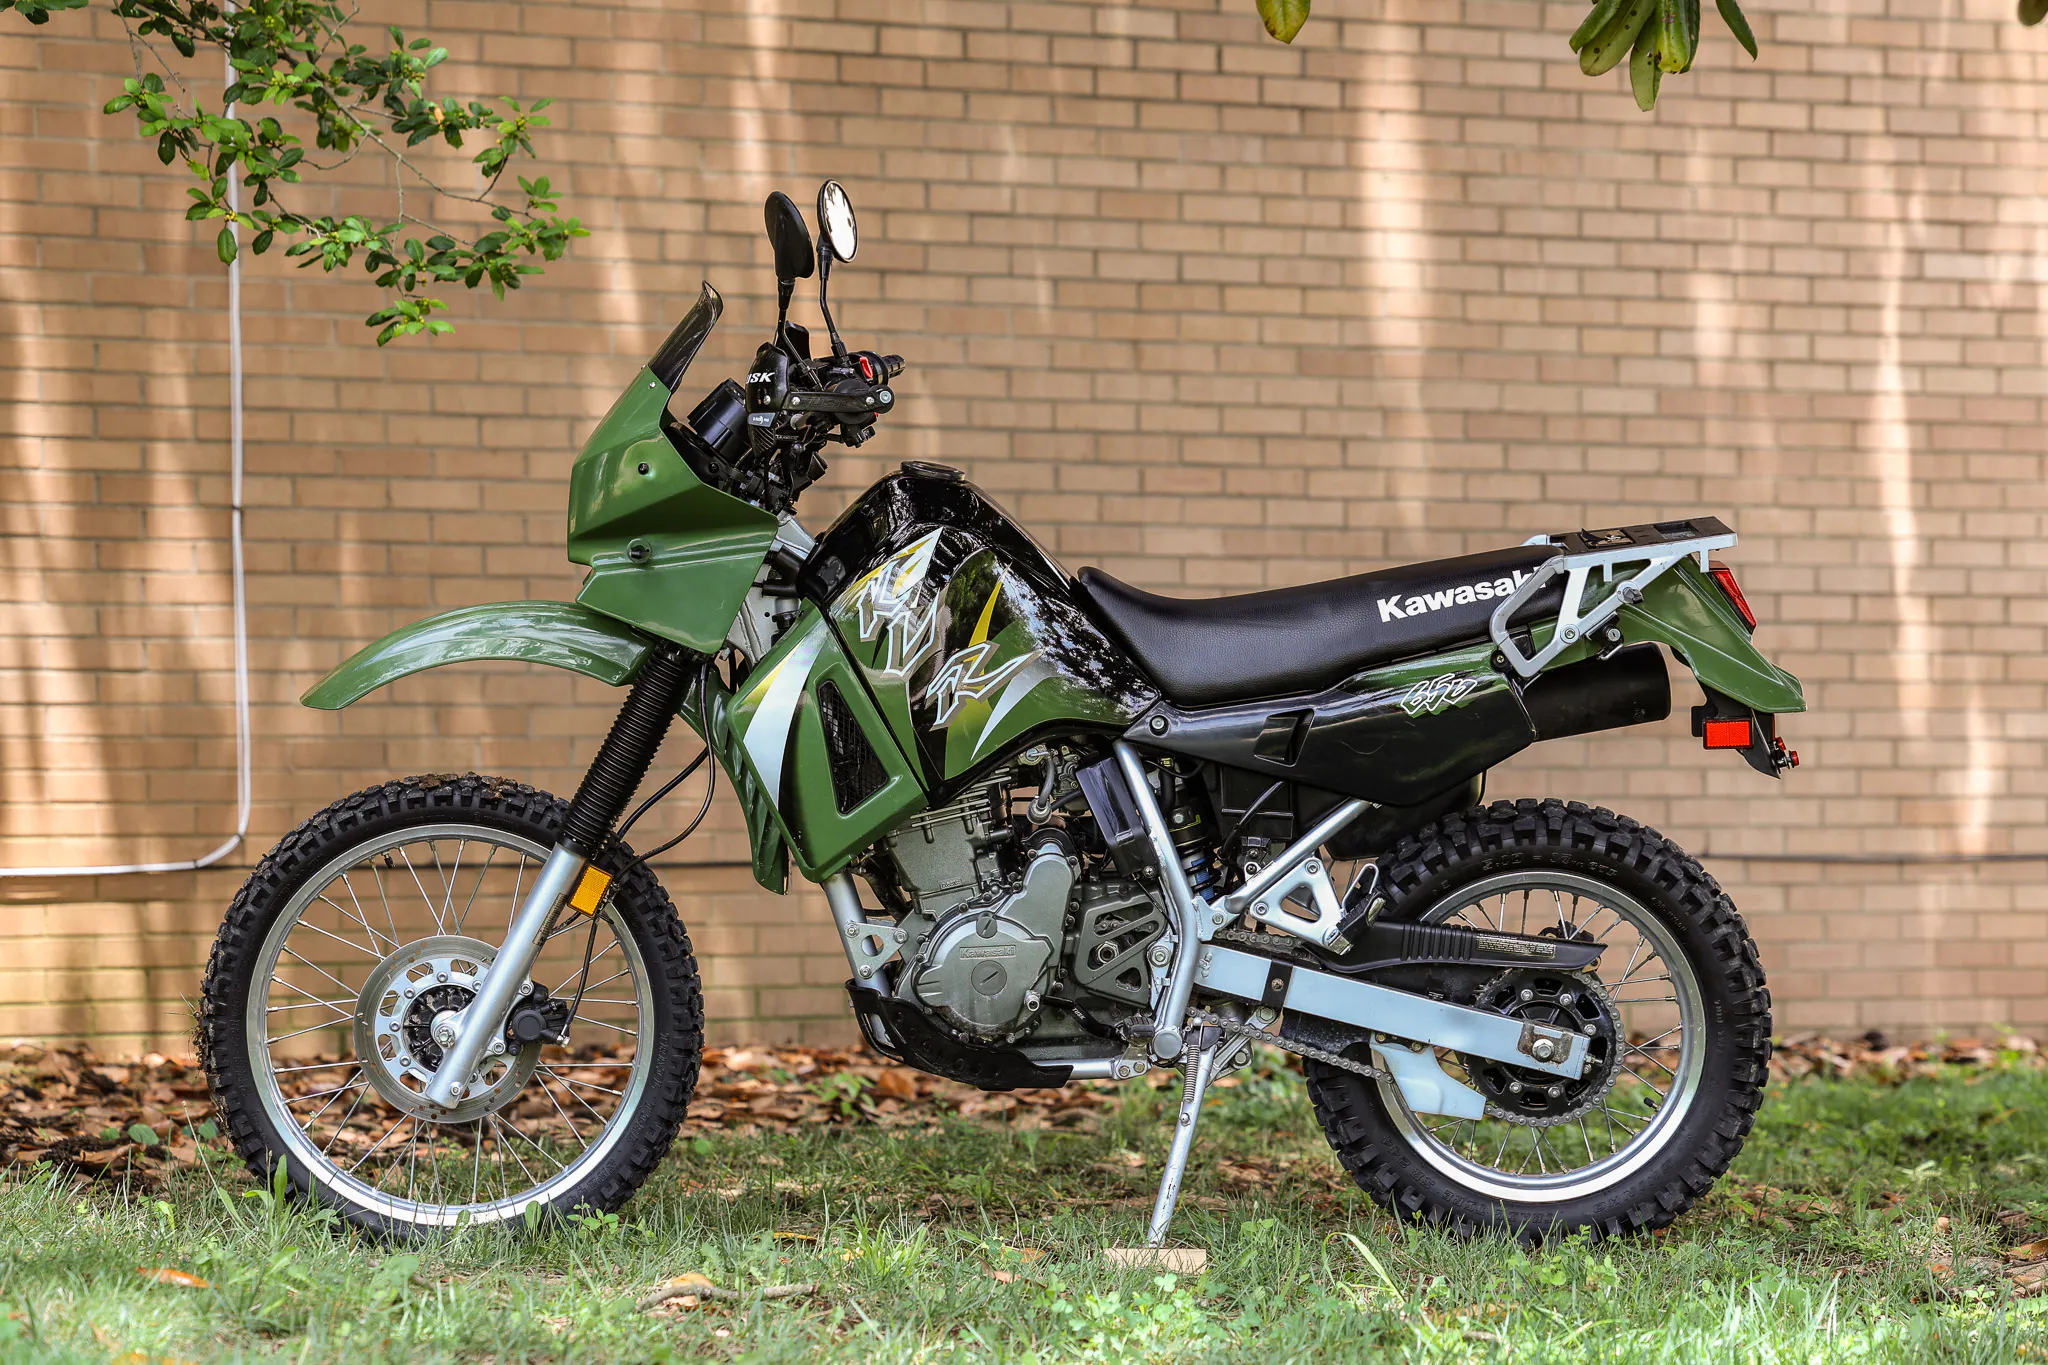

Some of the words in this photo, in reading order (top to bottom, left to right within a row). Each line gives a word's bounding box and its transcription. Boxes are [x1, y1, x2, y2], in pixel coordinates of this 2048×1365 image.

[1376, 566, 1547, 623] Kawasak
[1401, 673, 1478, 715] 650
[960, 946, 1015, 959] Kawasaki
